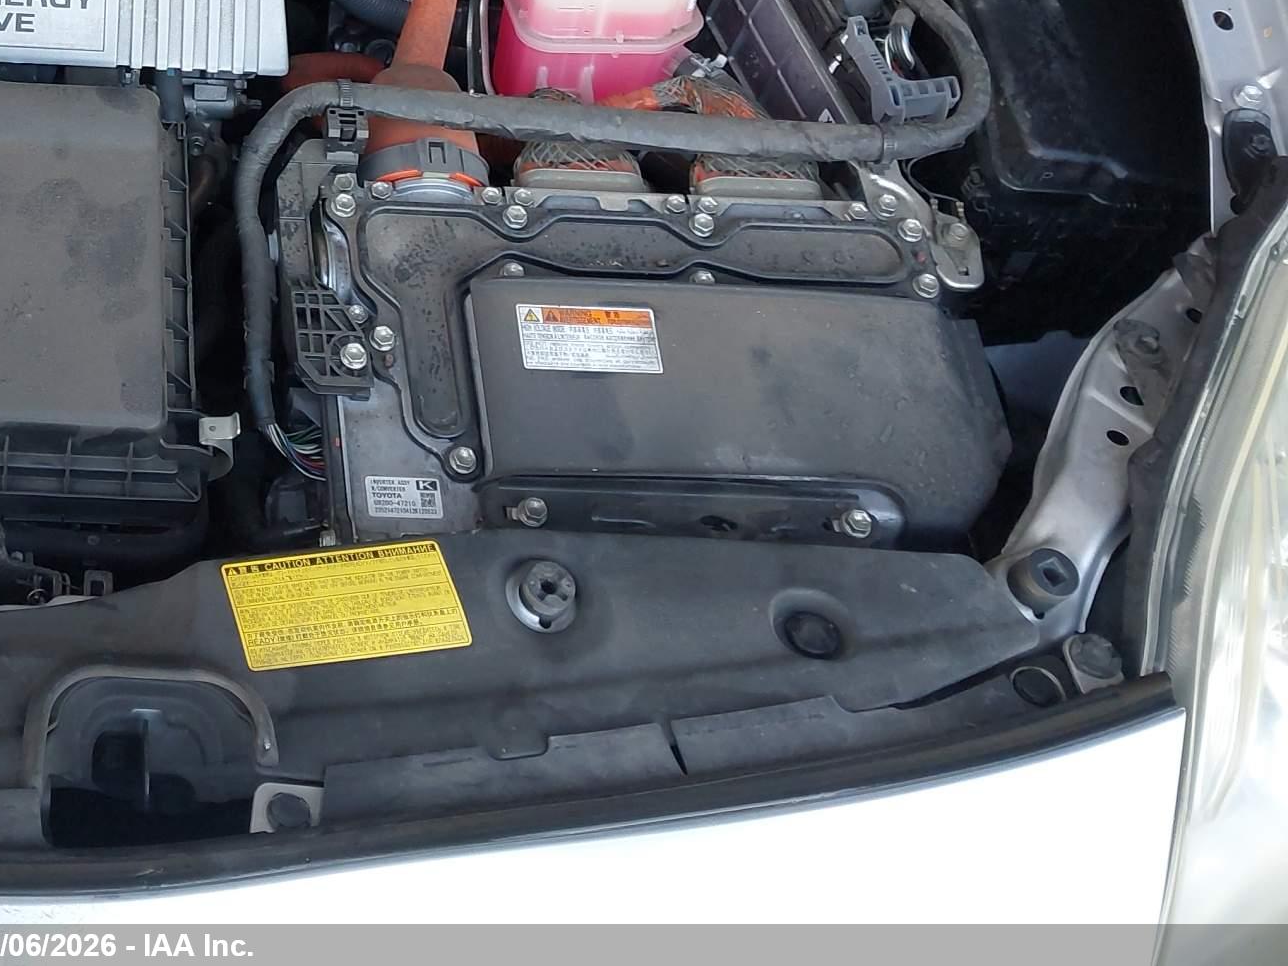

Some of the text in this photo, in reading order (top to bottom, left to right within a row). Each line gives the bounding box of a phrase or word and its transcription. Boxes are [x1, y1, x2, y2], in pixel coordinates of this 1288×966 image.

[264, 558, 311, 571] CAUTION
[316, 551, 374, 565] ATTENTION
[379, 544, 435, 559] ВНИМАНИЕ
